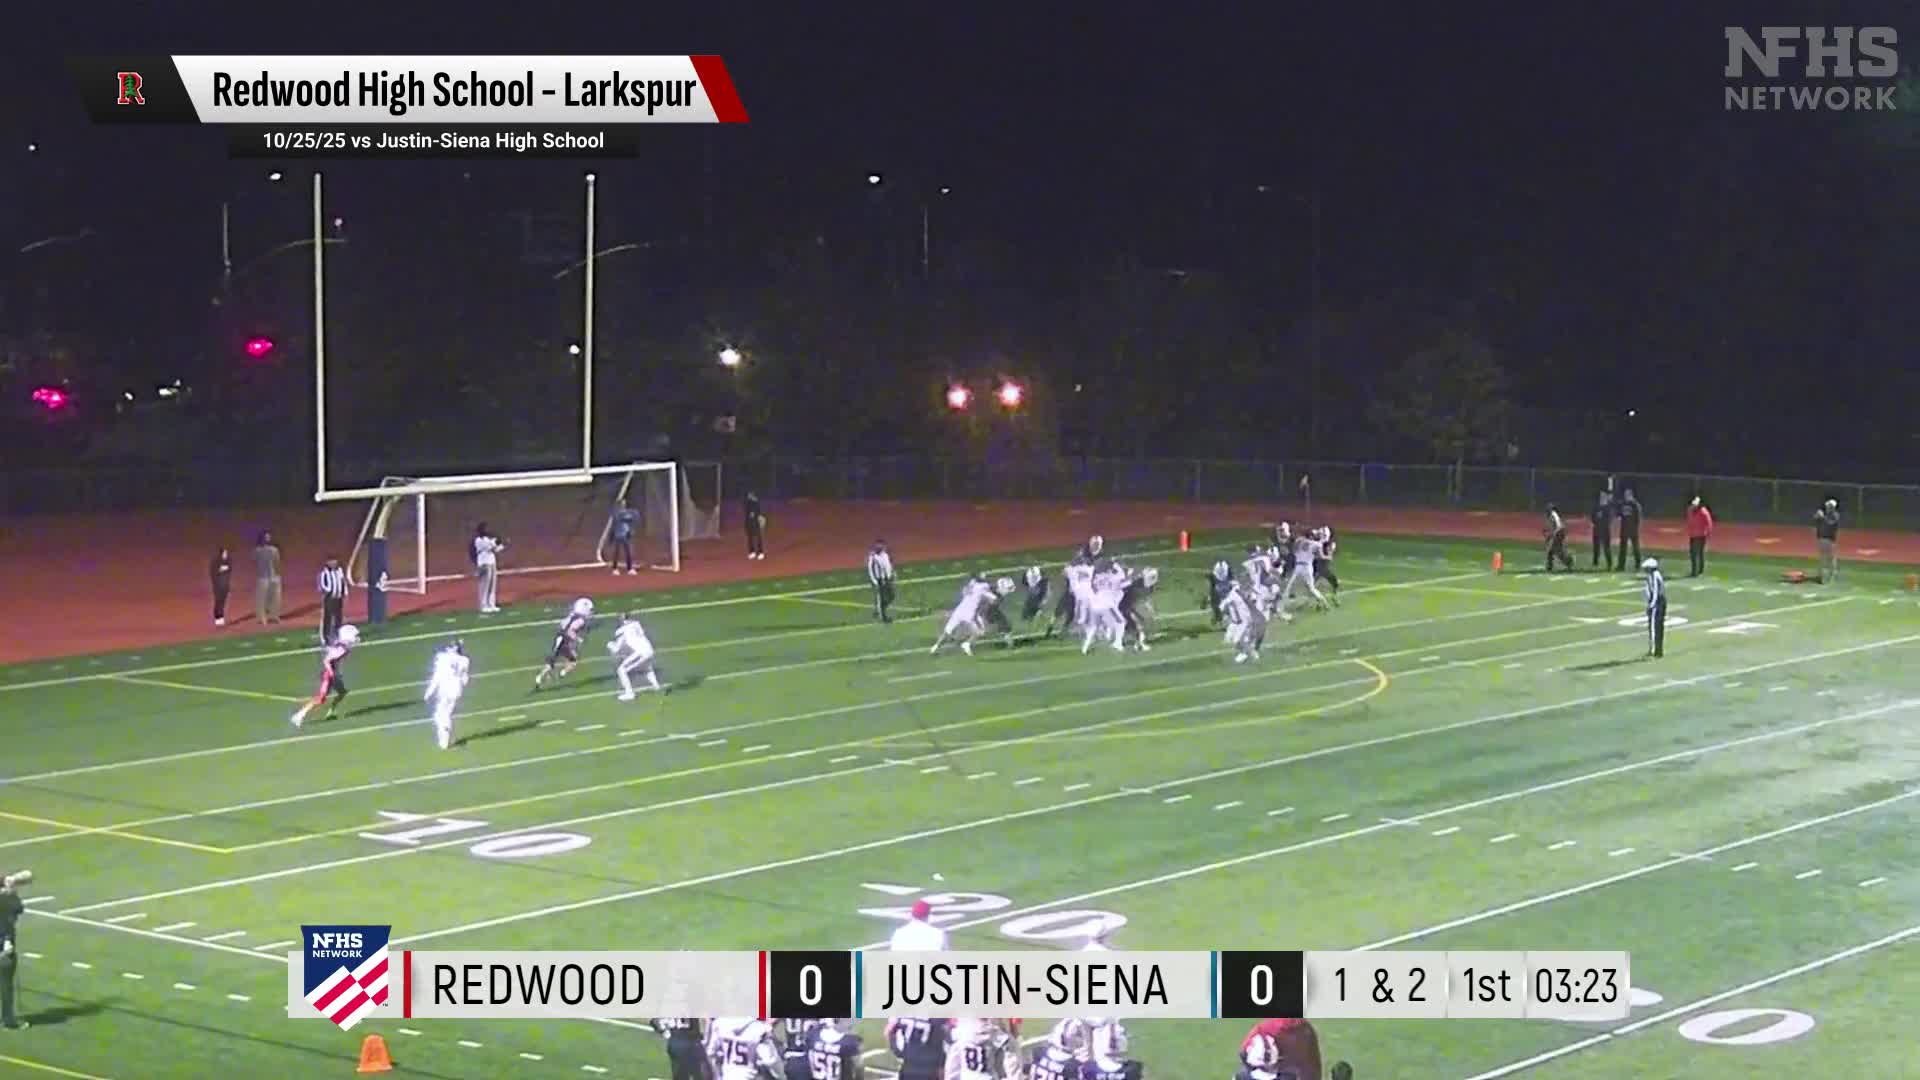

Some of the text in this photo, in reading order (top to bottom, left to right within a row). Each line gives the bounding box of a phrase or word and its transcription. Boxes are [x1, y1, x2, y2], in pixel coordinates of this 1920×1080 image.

[358, 814, 592, 857] 10
[857, 892, 1128, 939] 20
[901, 1017, 931, 1044] 77
[722, 1038, 750, 1066] 75
[965, 1046, 987, 1072] 81
